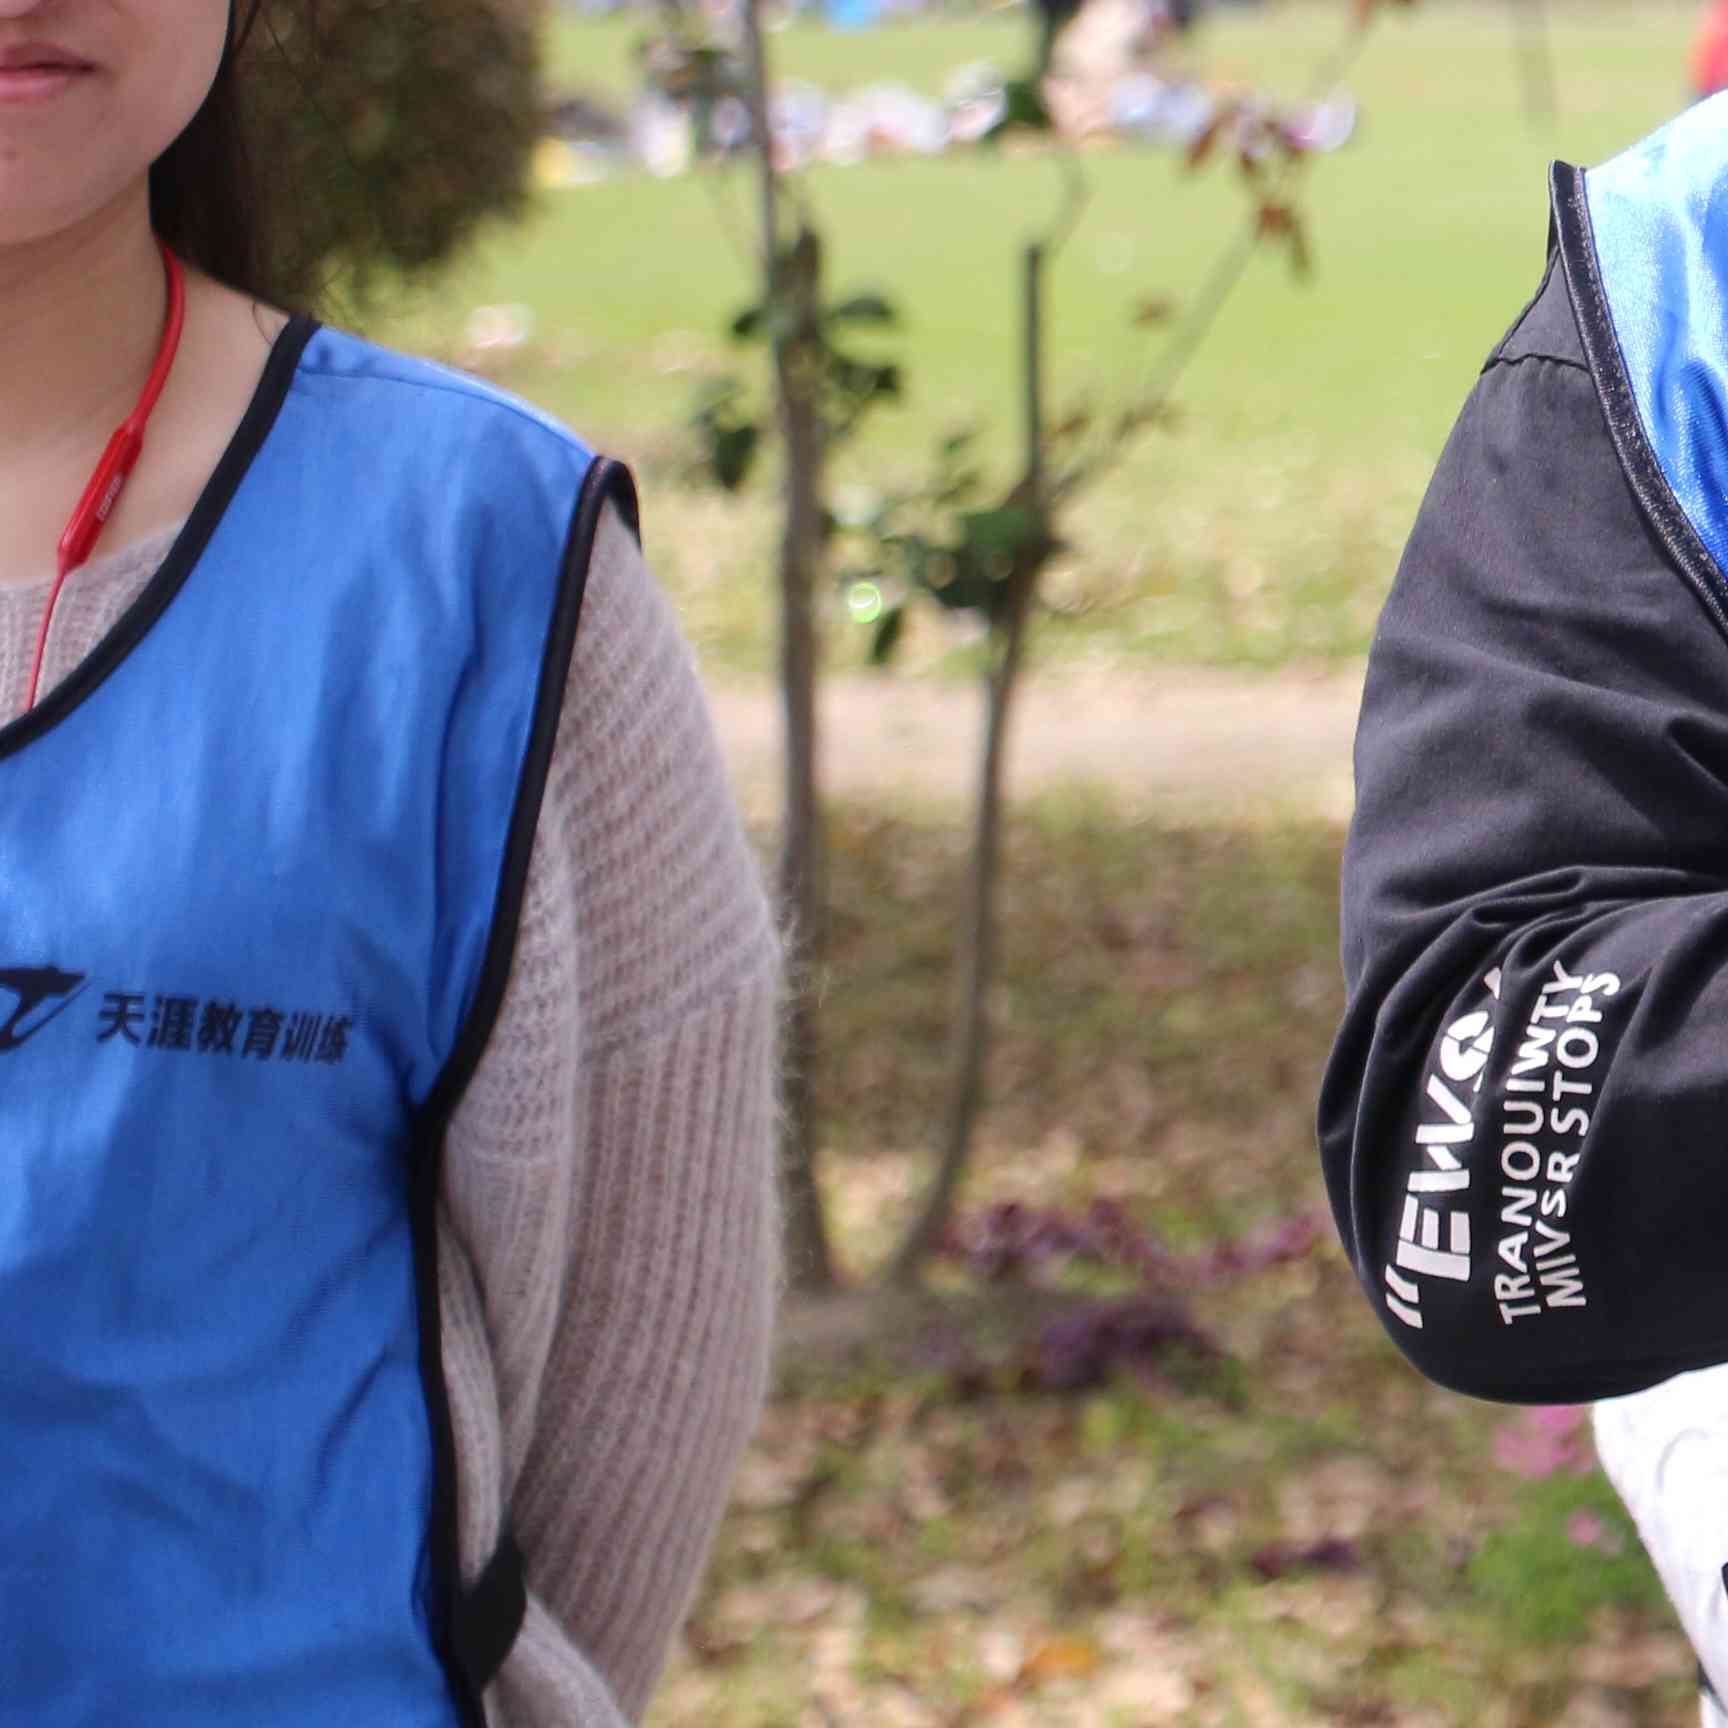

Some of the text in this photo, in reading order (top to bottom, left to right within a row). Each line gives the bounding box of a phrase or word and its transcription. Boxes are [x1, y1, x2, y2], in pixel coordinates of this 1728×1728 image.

[97, 992, 353, 1064] 天涯教育训练
